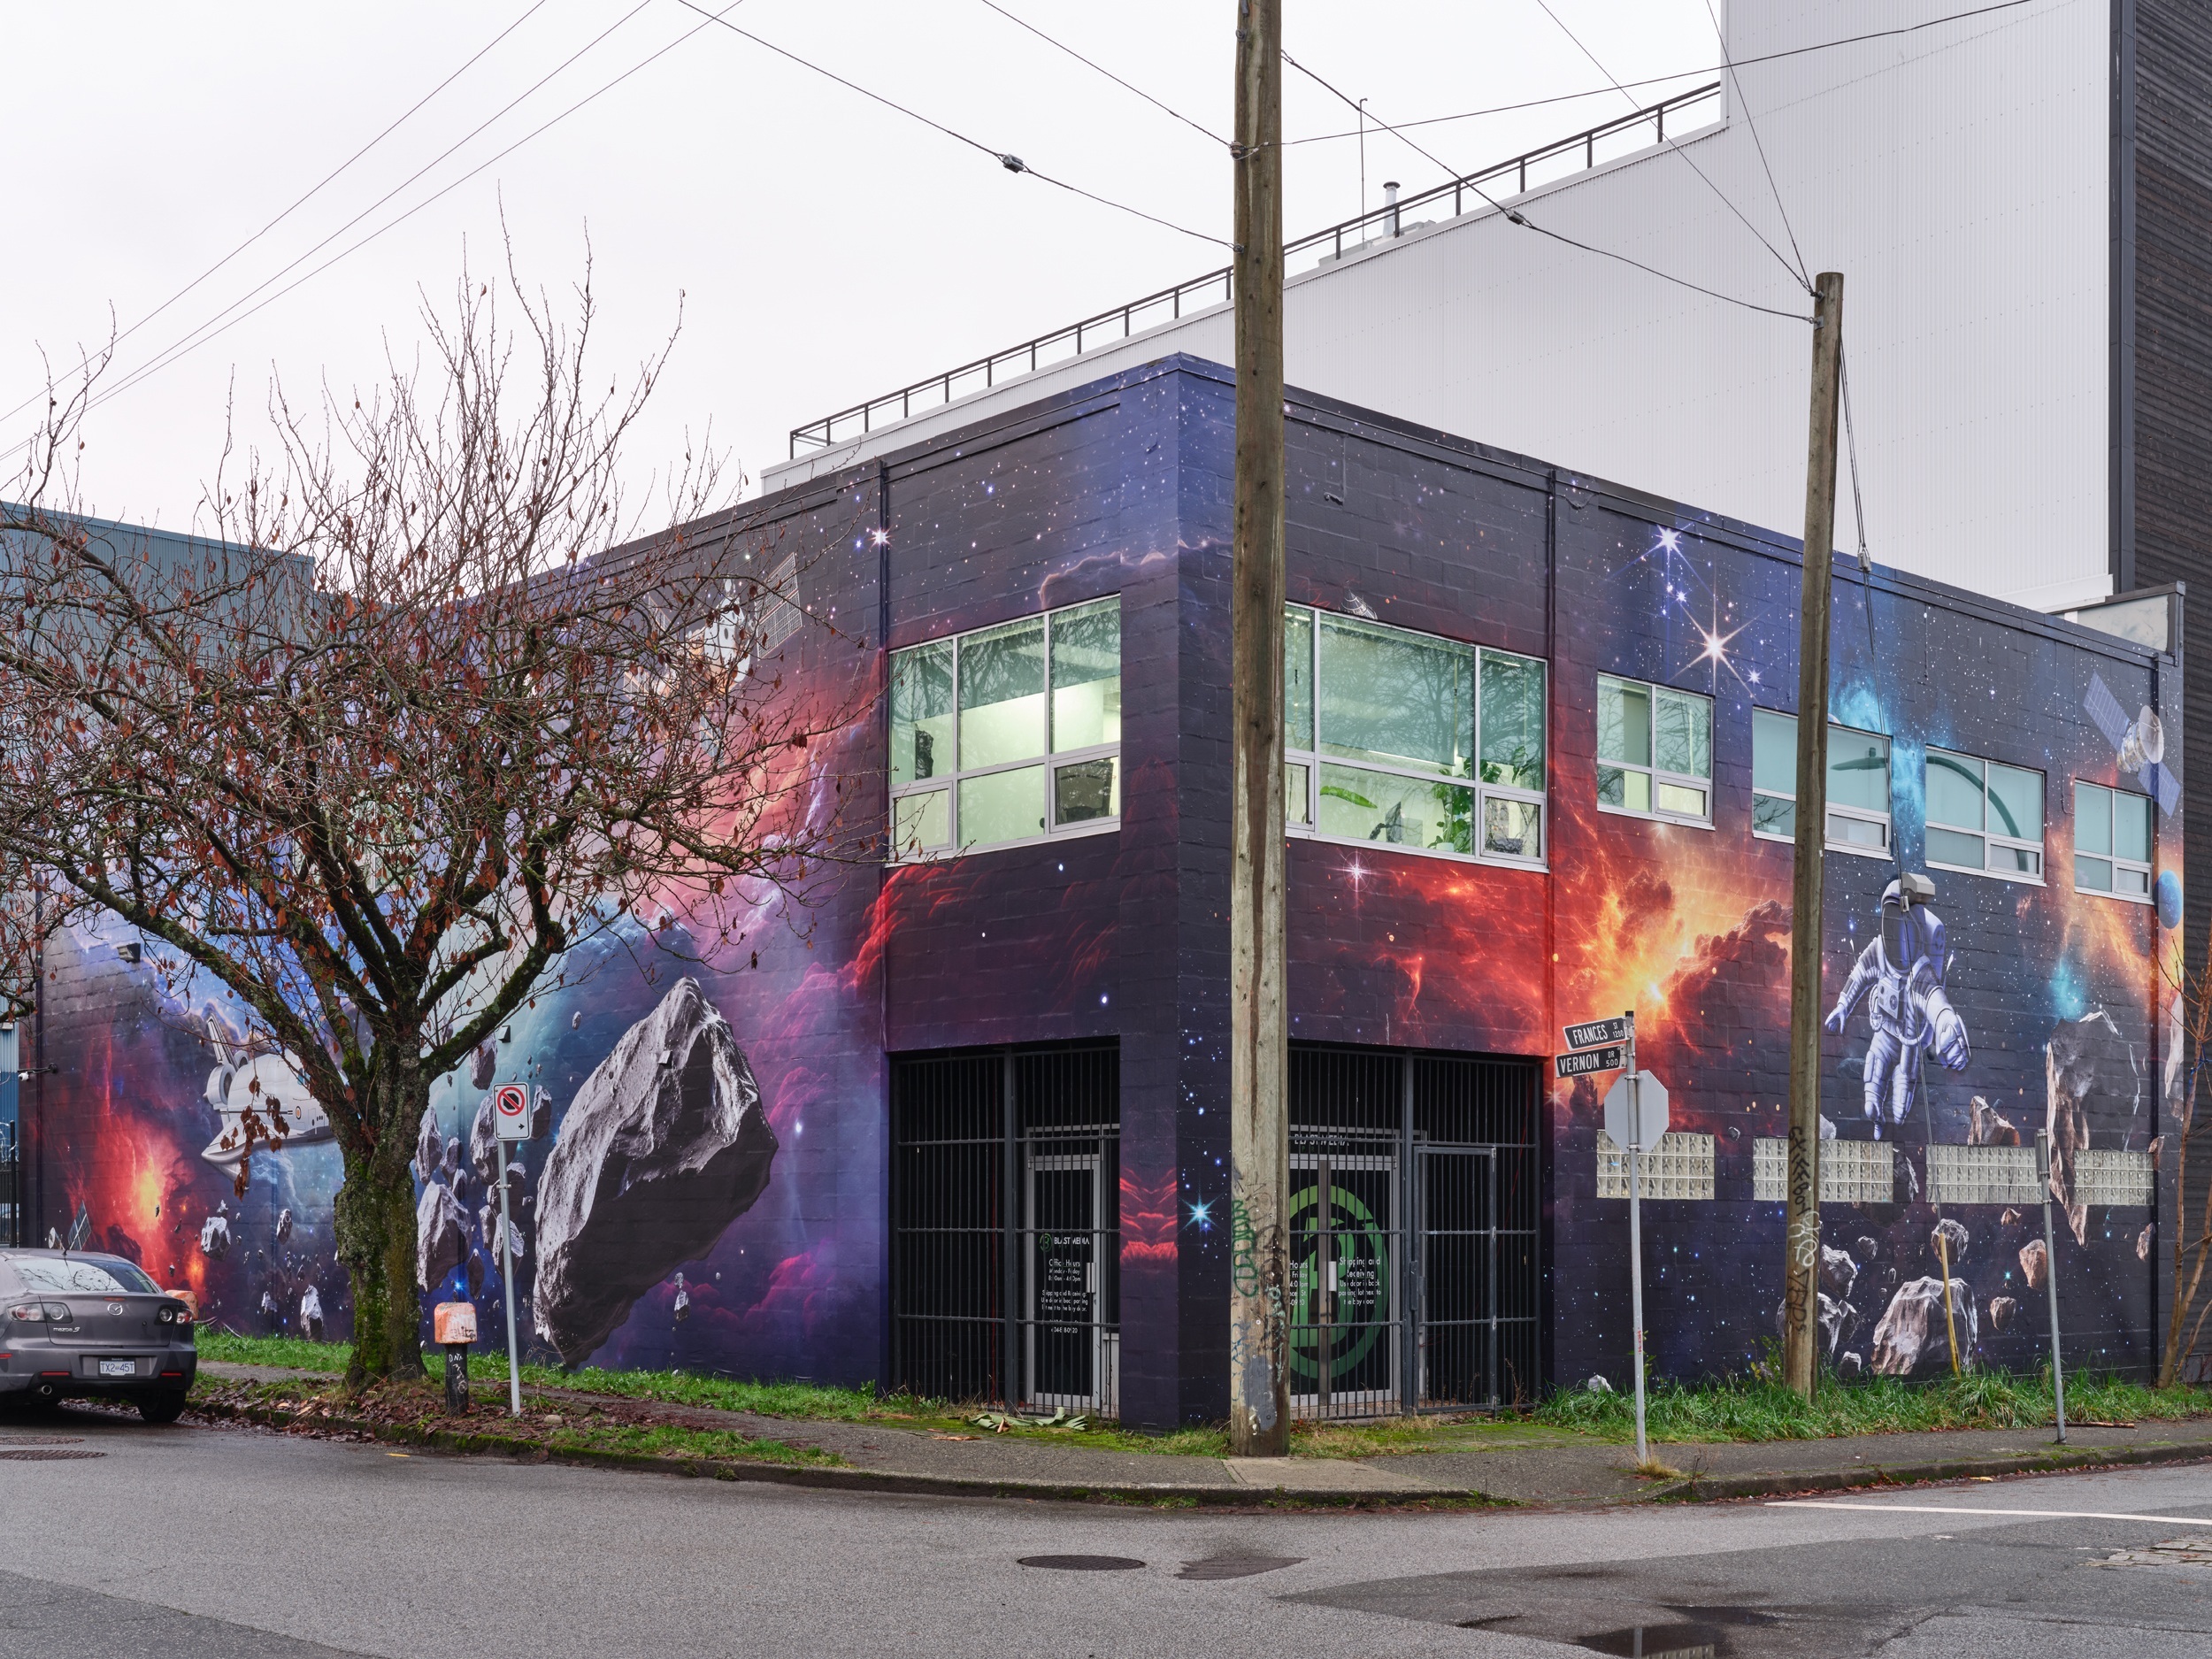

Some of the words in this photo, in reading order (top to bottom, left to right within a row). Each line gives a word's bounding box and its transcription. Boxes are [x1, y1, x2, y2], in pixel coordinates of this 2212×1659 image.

[1572, 1025, 1608, 1045] FRANCES
[1612, 1030, 1624, 1039] 1200
[1560, 1053, 1600, 1073] VERNON
[1347, 1269, 1375, 1280] eceivng
[101, 1363, 116, 1372] TX2
[119, 1363, 134, 1372] 45T
